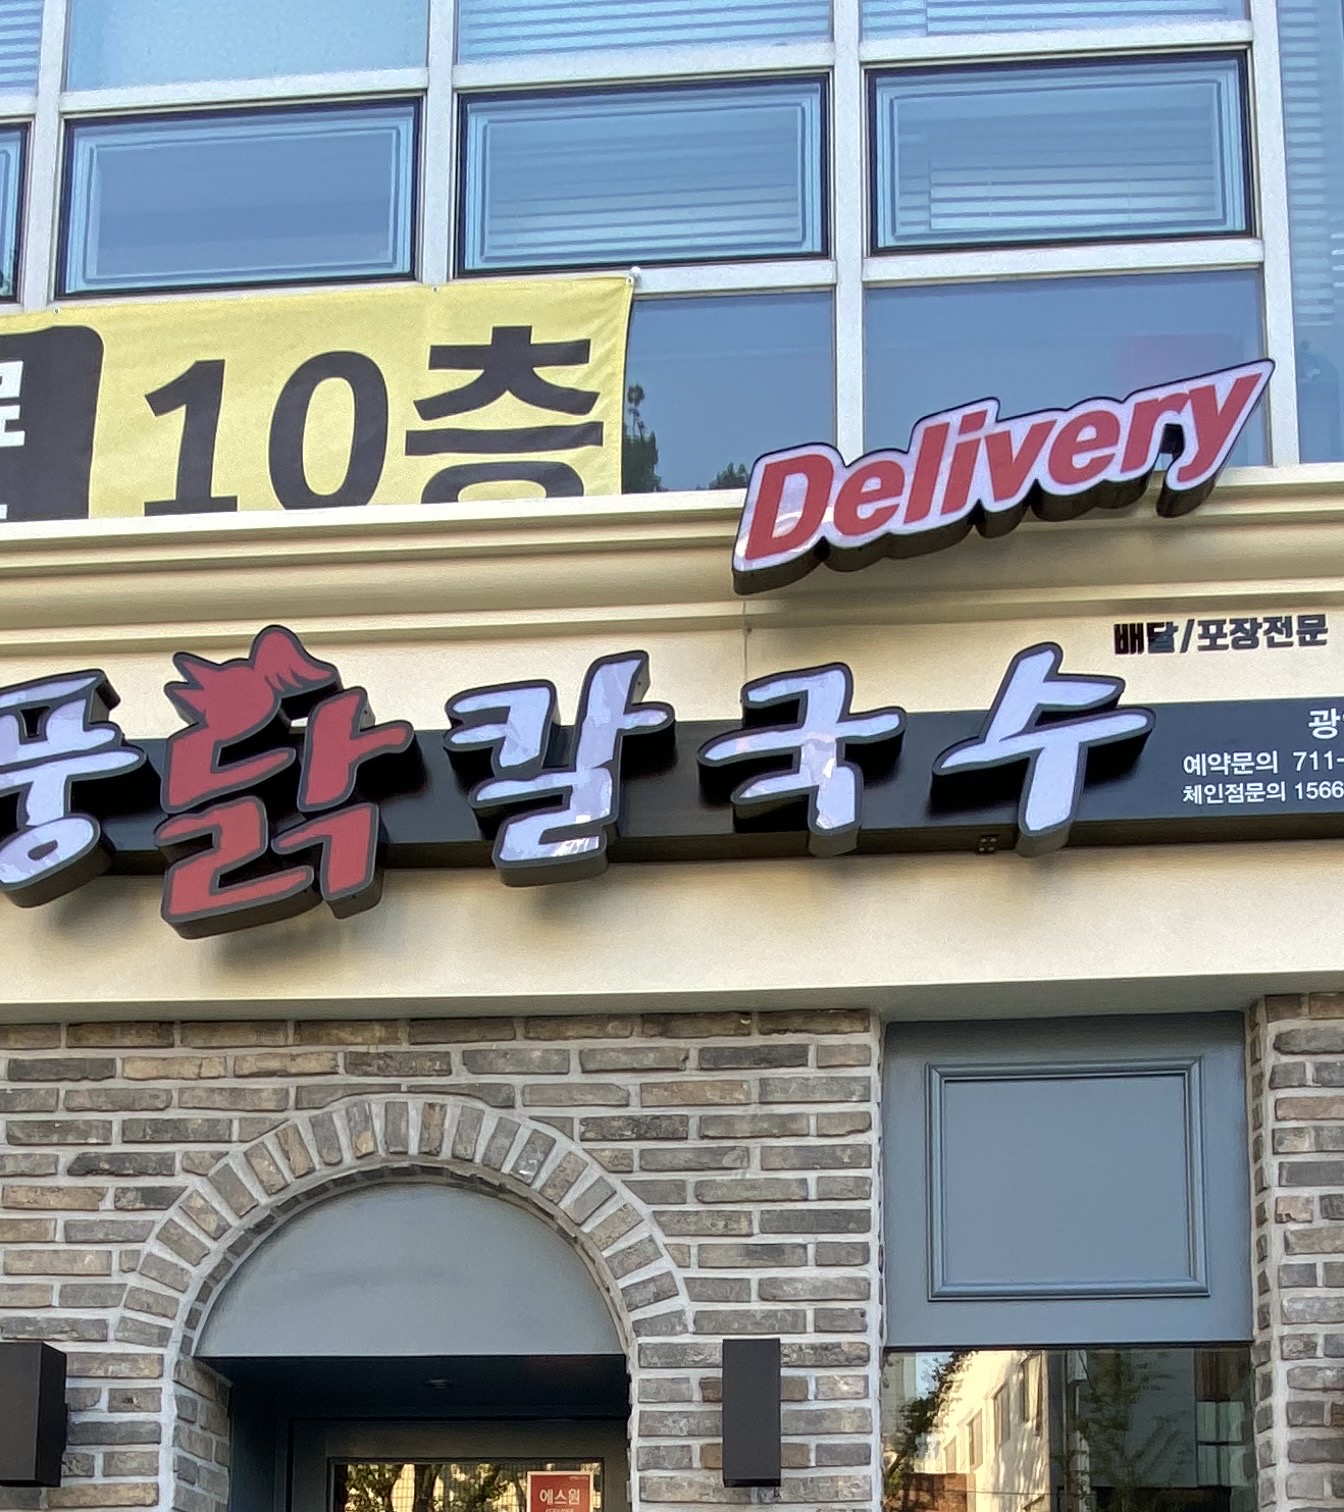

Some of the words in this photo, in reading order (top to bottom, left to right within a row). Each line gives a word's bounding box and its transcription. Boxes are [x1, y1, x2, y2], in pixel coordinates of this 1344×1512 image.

[143, 325, 604, 517] 10층
[733, 358, 1276, 593] Delivery
[1113, 613, 1329, 656] 배달/포장전문
[1182, 751, 1280, 777] 예약문의
[1182, 781, 1287, 806] 체인점문의
[539, 1488, 581, 1506] 에스원
